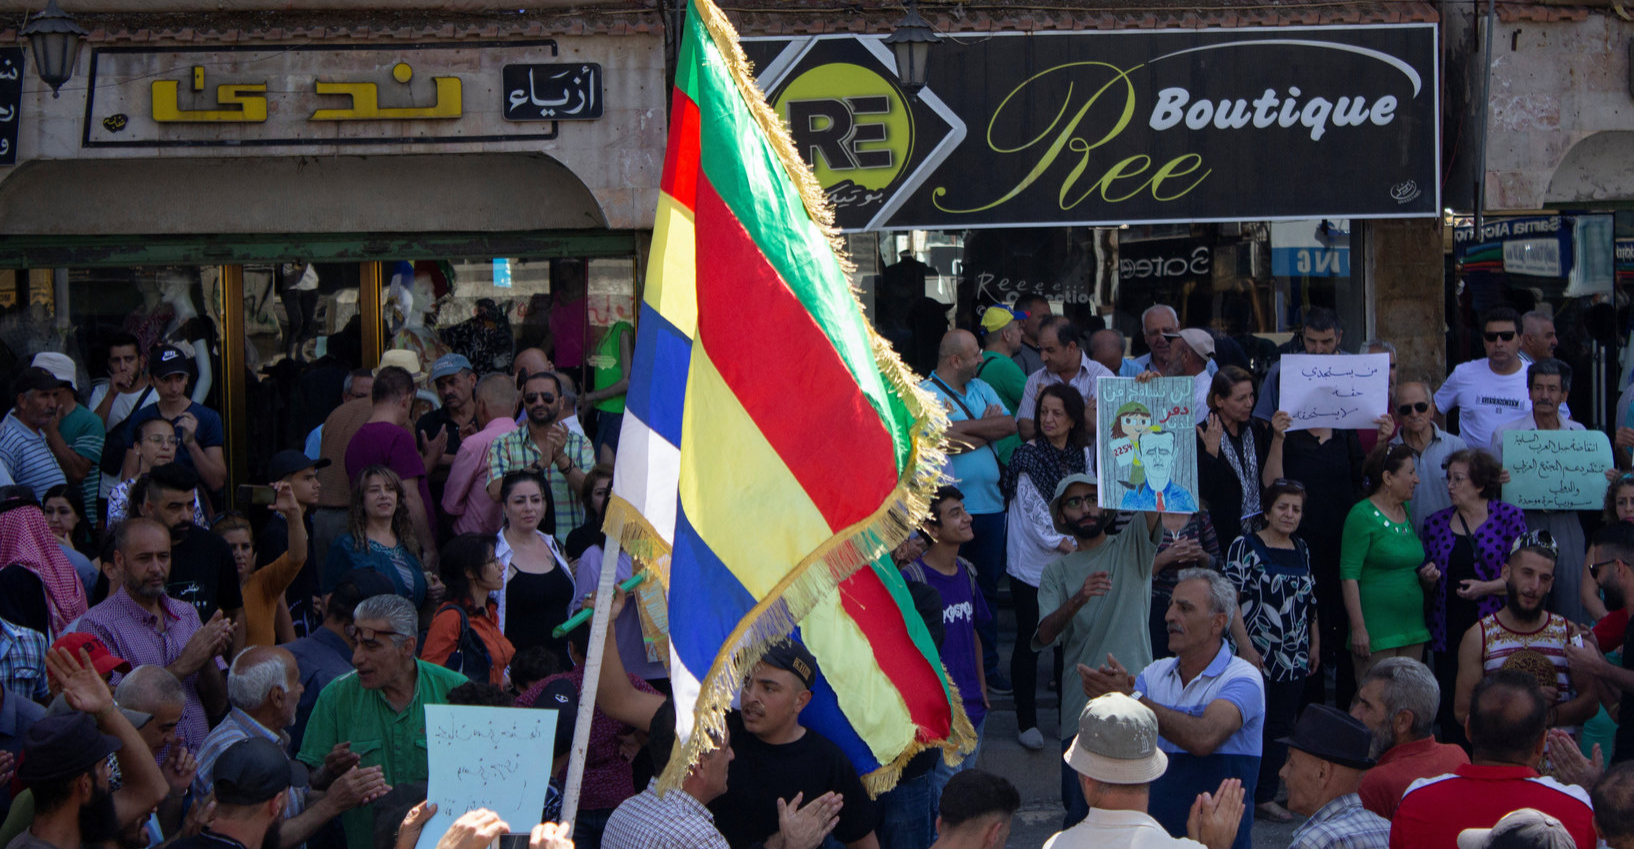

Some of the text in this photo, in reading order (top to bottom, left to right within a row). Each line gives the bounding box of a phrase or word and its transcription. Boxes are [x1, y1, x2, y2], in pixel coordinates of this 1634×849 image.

[785, 95, 893, 170] RE
[931, 61, 1212, 215] Ree
[1148, 85, 1399, 142] Boutique
[1354, 366, 1378, 378] من
[1113, 443, 1133, 457] 2254
